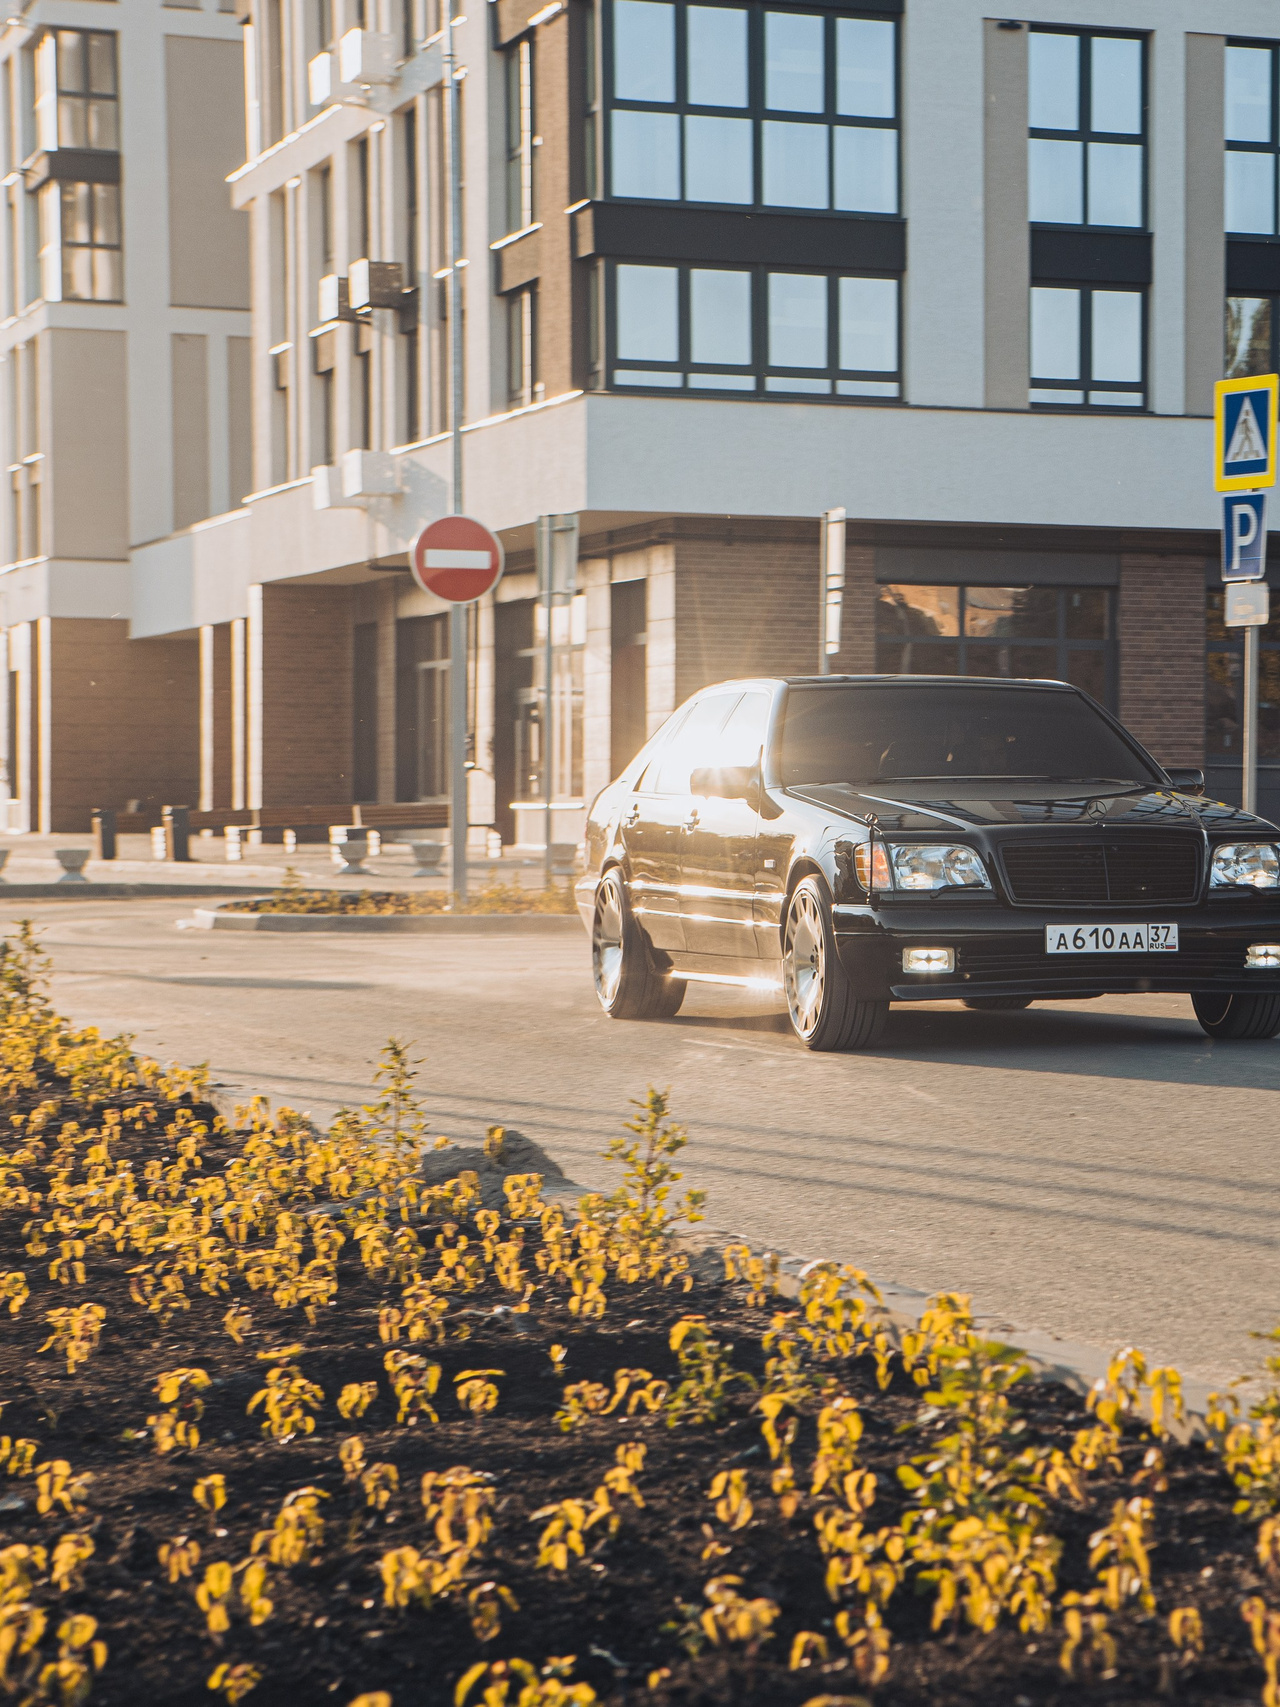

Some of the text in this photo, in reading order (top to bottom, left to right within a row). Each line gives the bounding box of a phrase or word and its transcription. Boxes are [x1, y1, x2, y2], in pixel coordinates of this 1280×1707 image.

[1231, 503, 1258, 570] P
[1150, 925, 1171, 943] 37
[1149, 942, 1165, 950] RUS
